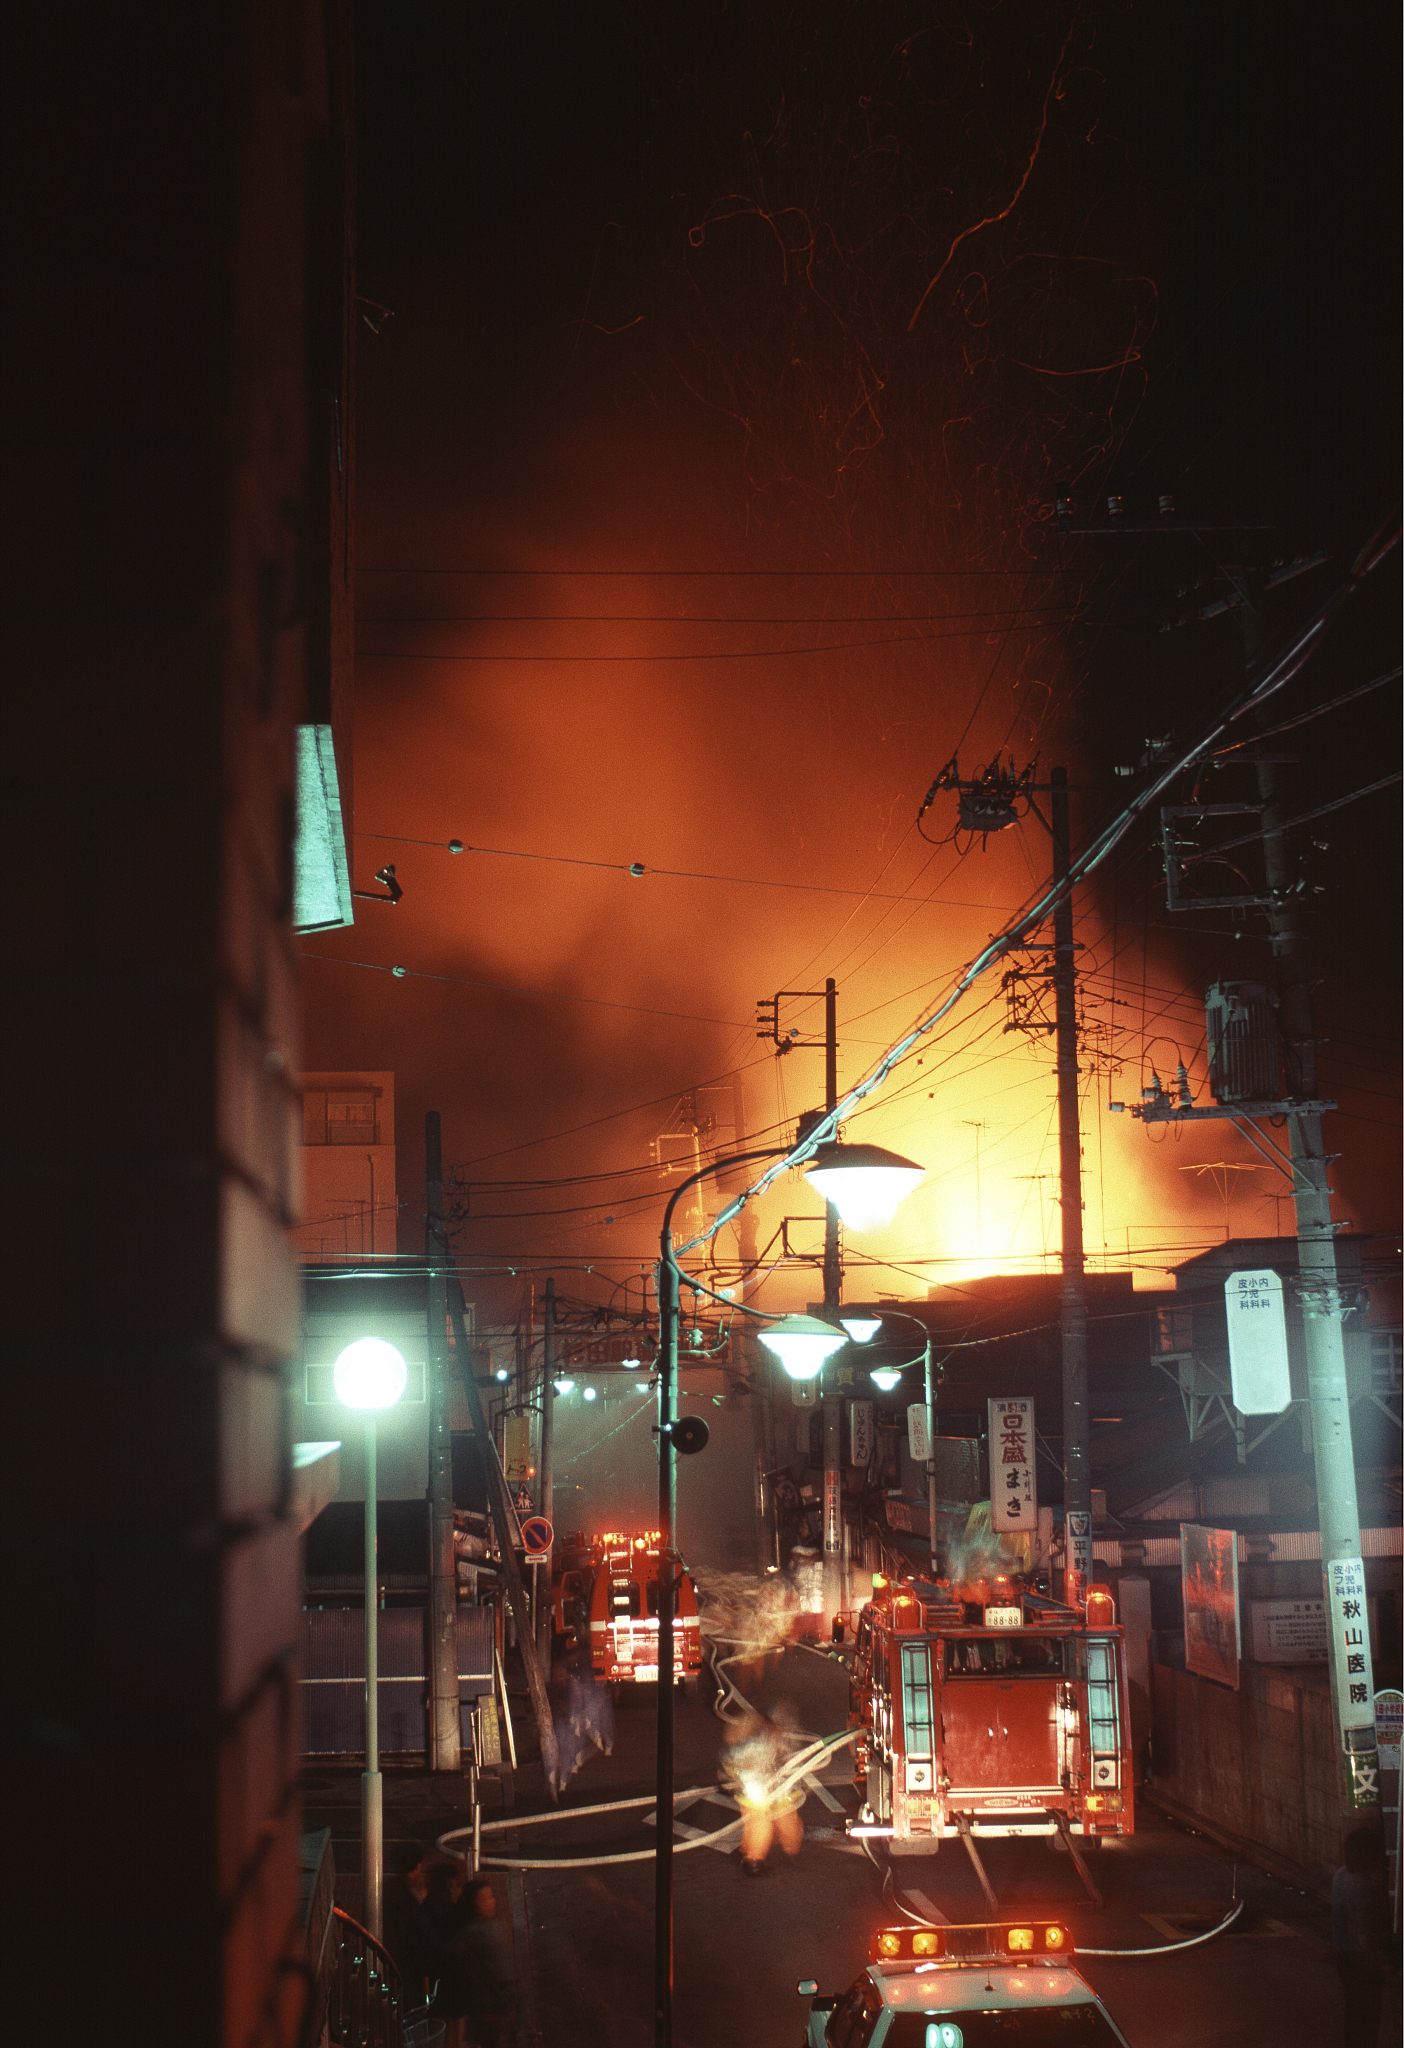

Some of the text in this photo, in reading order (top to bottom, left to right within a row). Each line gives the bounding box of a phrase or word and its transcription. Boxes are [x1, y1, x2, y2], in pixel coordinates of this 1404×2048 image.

[1238, 1279, 1249, 1309] 皮フ科
[1248, 1278, 1260, 1308] 小児科
[1258, 1278, 1270, 1308] 内科
[1000, 1414, 1027, 1464] 日本盛
[1006, 1468, 1022, 1517] まき
[1333, 1565, 1345, 1596] 皮フ科
[1344, 1565, 1355, 1595] 小児科
[1354, 1564, 1363, 1594] 内科
[1342, 1599, 1368, 1704] 秋山医院
[1354, 1764, 1379, 1794] 文
